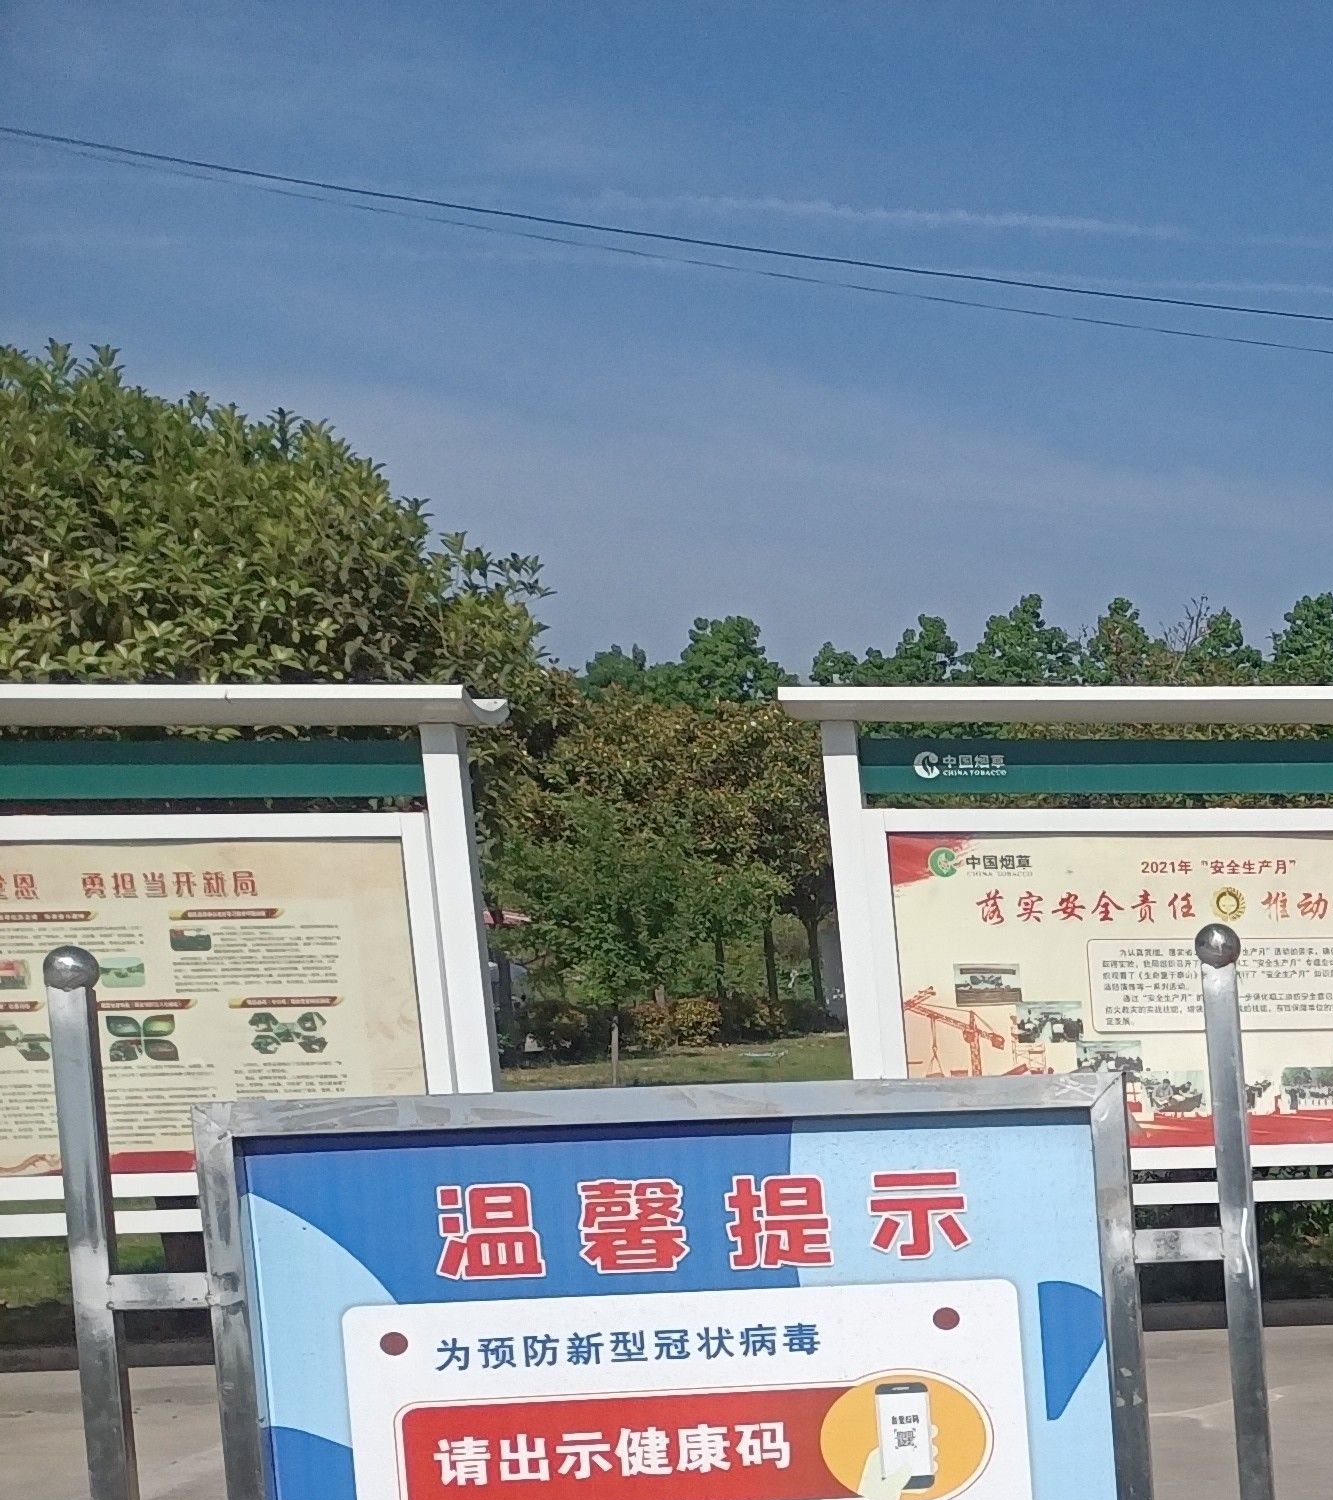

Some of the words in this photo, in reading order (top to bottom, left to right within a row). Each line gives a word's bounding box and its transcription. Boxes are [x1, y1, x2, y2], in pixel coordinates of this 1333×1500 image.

[942, 754, 1005, 768] 中国烟草
[942, 769, 969, 777] CHINA
[970, 769, 1007, 777] TOBACCO
[965, 854, 1032, 870] 中国烟草
[81, 870, 260, 899] 勇担当开新局
[975, 888, 1196, 926] 落实安全责任
[431, 1168, 972, 1282] 温馨提示
[434, 1321, 821, 1371] 为预防新型冠状病毒
[433, 1420, 792, 1487] 请出示健康码
